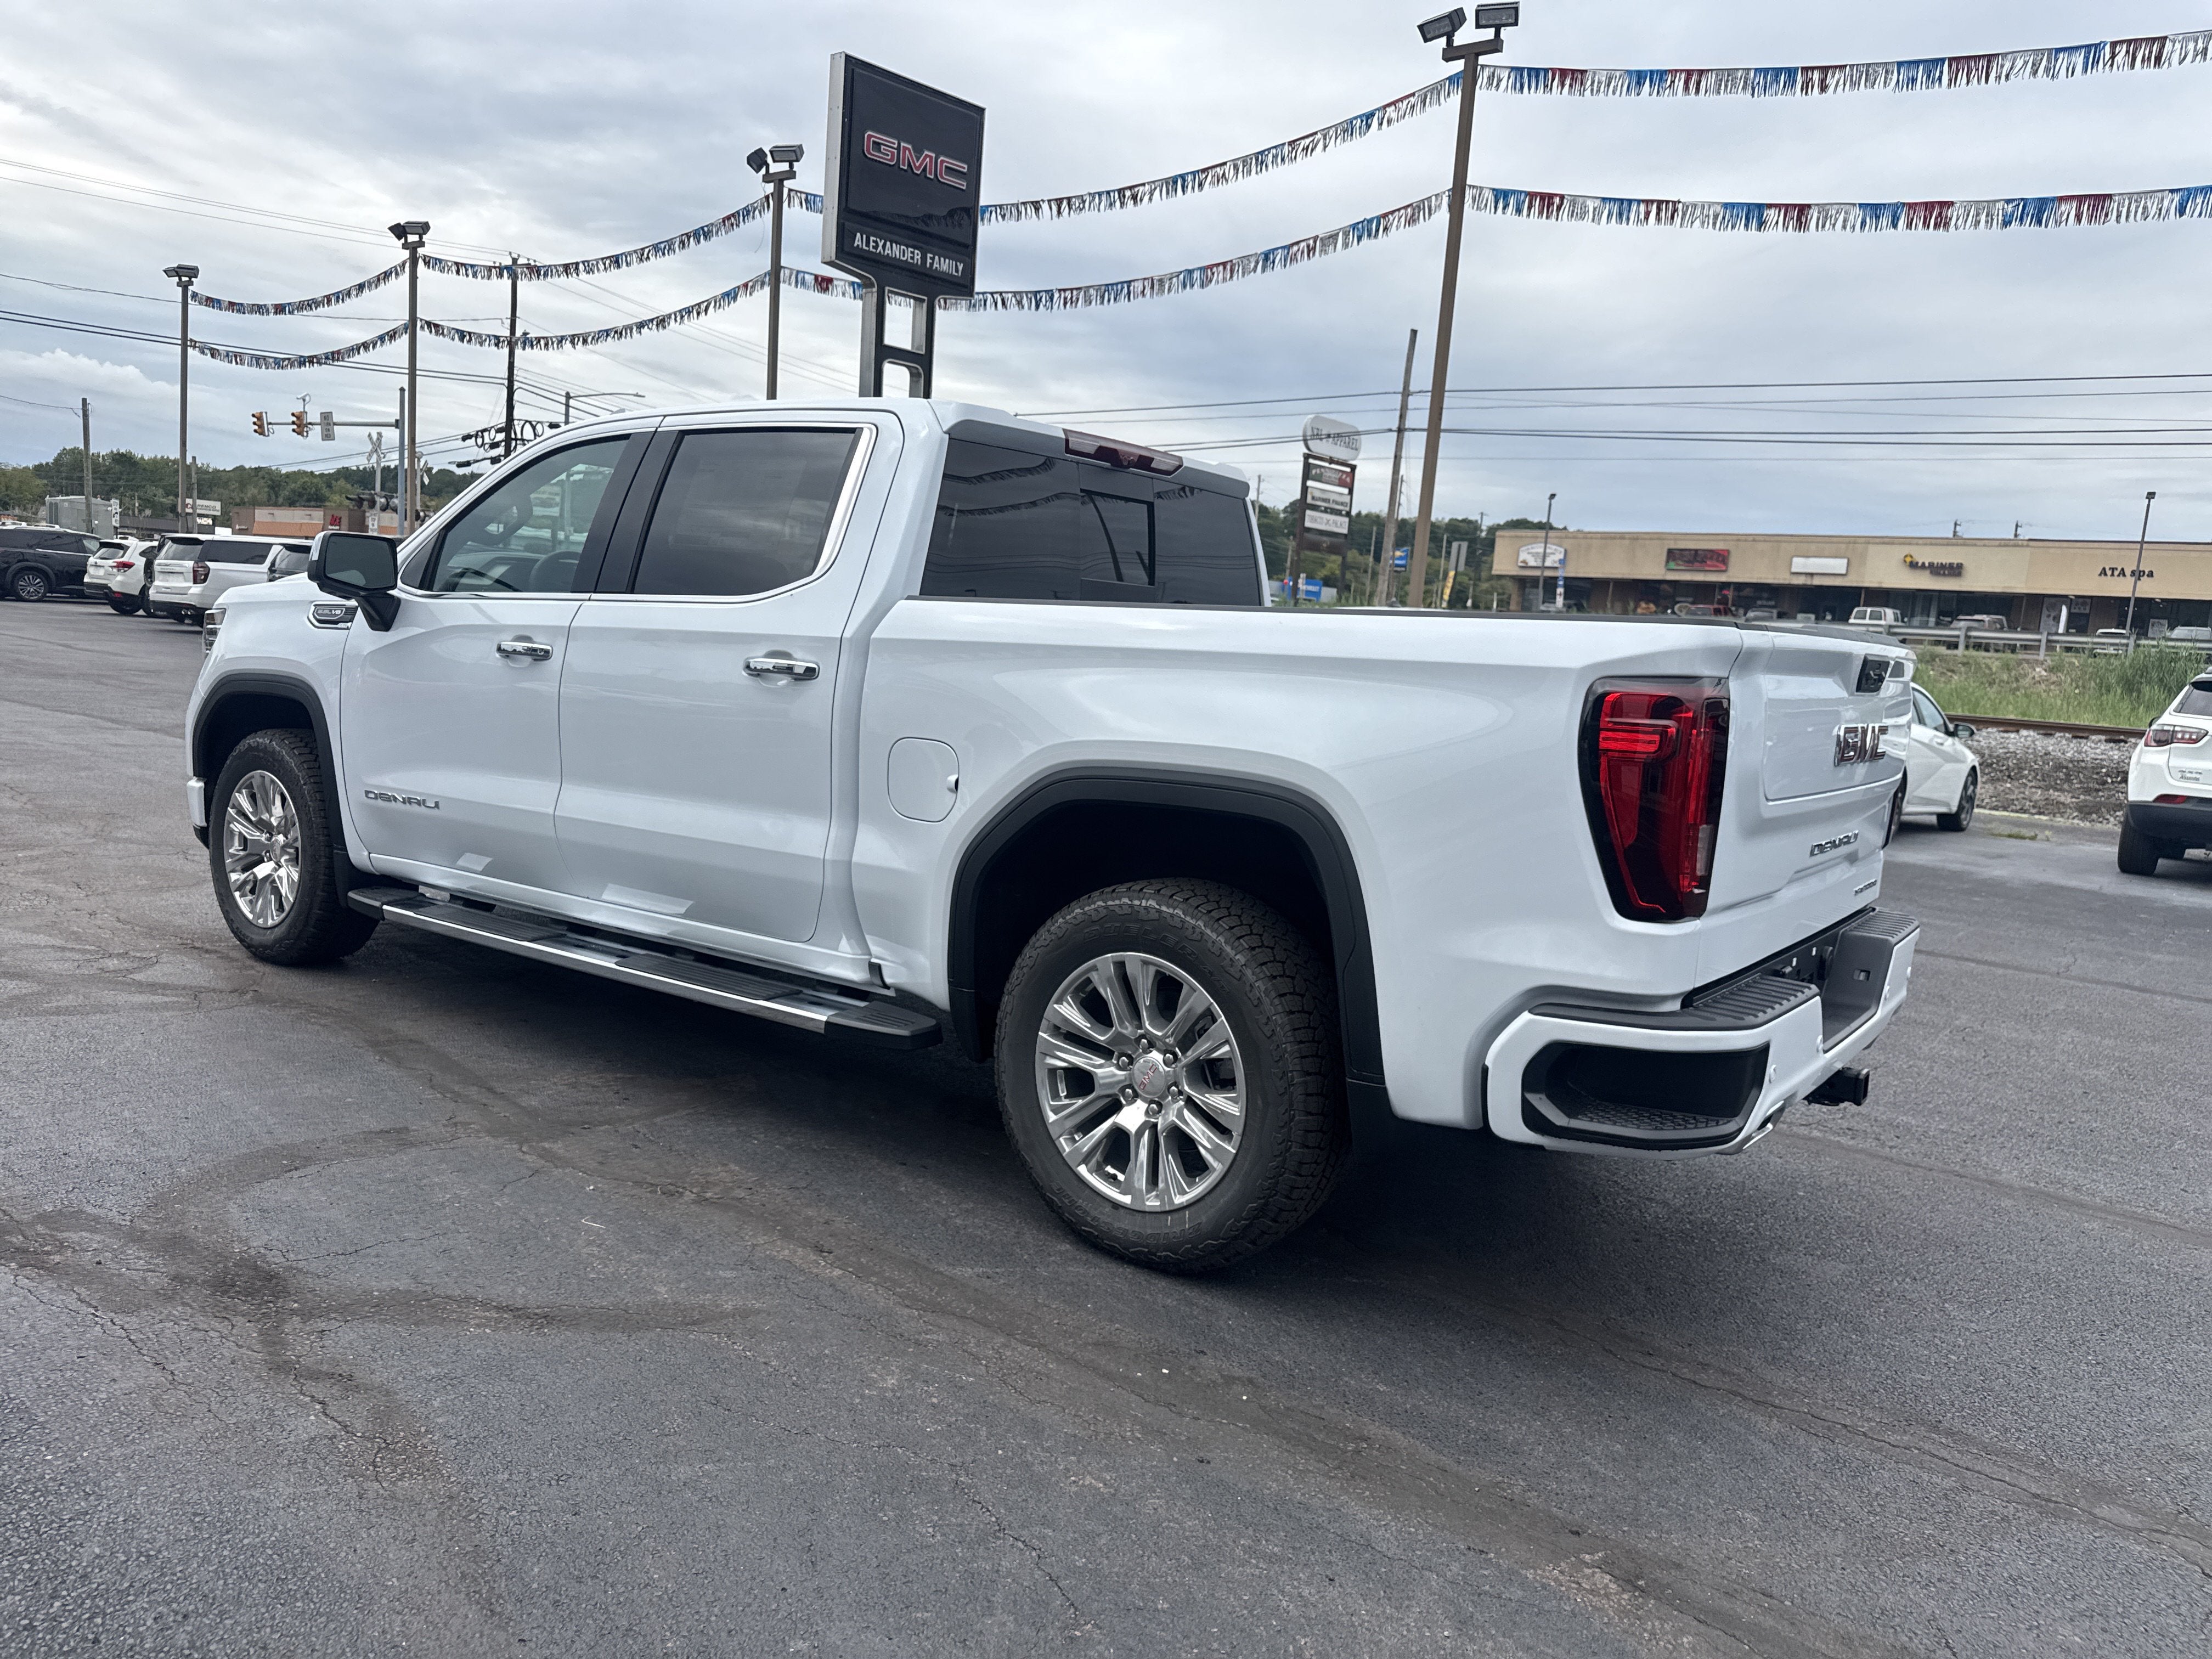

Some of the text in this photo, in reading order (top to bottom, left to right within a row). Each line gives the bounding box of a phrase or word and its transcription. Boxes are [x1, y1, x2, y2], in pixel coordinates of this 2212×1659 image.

[864, 131, 967, 190] GMC
[854, 233, 964, 277] ALEXANDER FAMILY
[2098, 567, 2154, 580] ATA spa
[1834, 723, 1888, 767] GMC
[364, 789, 440, 810] DENALI
[1139, 1063, 1158, 1091] GMC
[1049, 1180, 1204, 1244] BRIDGESTONE
